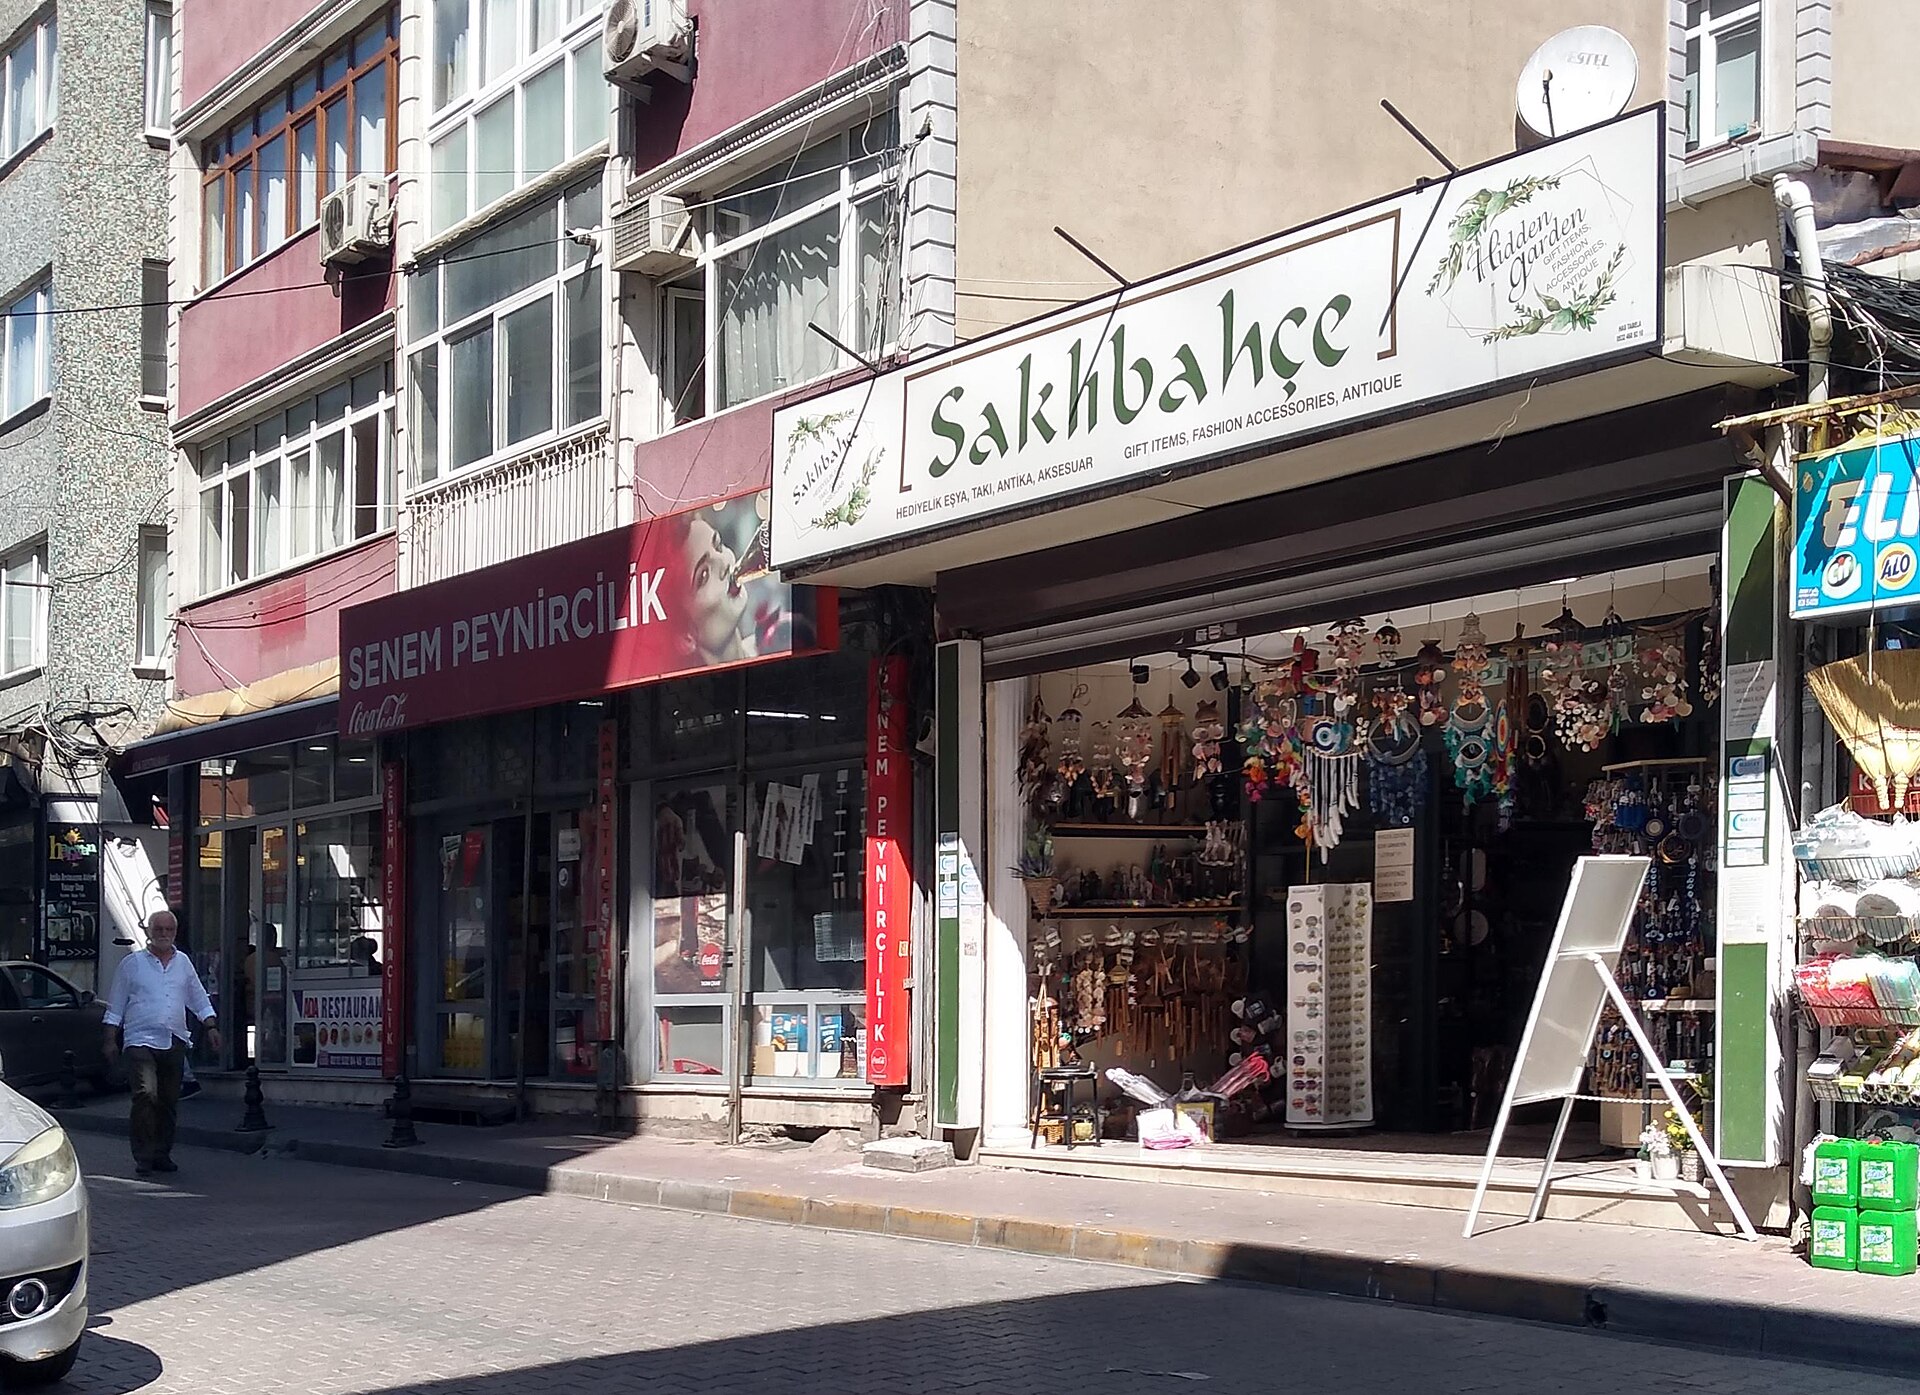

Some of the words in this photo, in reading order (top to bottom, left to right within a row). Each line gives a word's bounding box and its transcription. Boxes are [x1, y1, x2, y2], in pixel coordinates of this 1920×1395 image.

[1467, 211, 1552, 283] Hidden
[1508, 208, 1586, 303] garden
[1543, 246, 1563, 266] GIFT
[1552, 238, 1588, 272] FASHION
[1562, 258, 1599, 293] ANTIQUE
[1124, 441, 1148, 459] GIFT
[1151, 431, 1189, 453] ITEMS,
[1192, 416, 1243, 441] FASHION
[1246, 391, 1338, 428] ACCESSORIES,
[1342, 374, 1403, 401] ANTIQUE
[896, 495, 942, 520] HEDİYELİK
[944, 490, 970, 508] EŞYA,
[972, 482, 995, 498] TAKI,
[997, 473, 1036, 493] ANTİKA,
[1038, 456, 1094, 482] AKSESUAR
[1880, 553, 1911, 580] ALO
[348, 626, 442, 691] SENEM
[452, 562, 668, 667] PEYNİRCİLİK
[386, 768, 395, 850] SENEM
[385, 864, 394, 1046] PEYNİRCİLİK
[874, 796, 888, 1042] PEYNİRCİLİK
